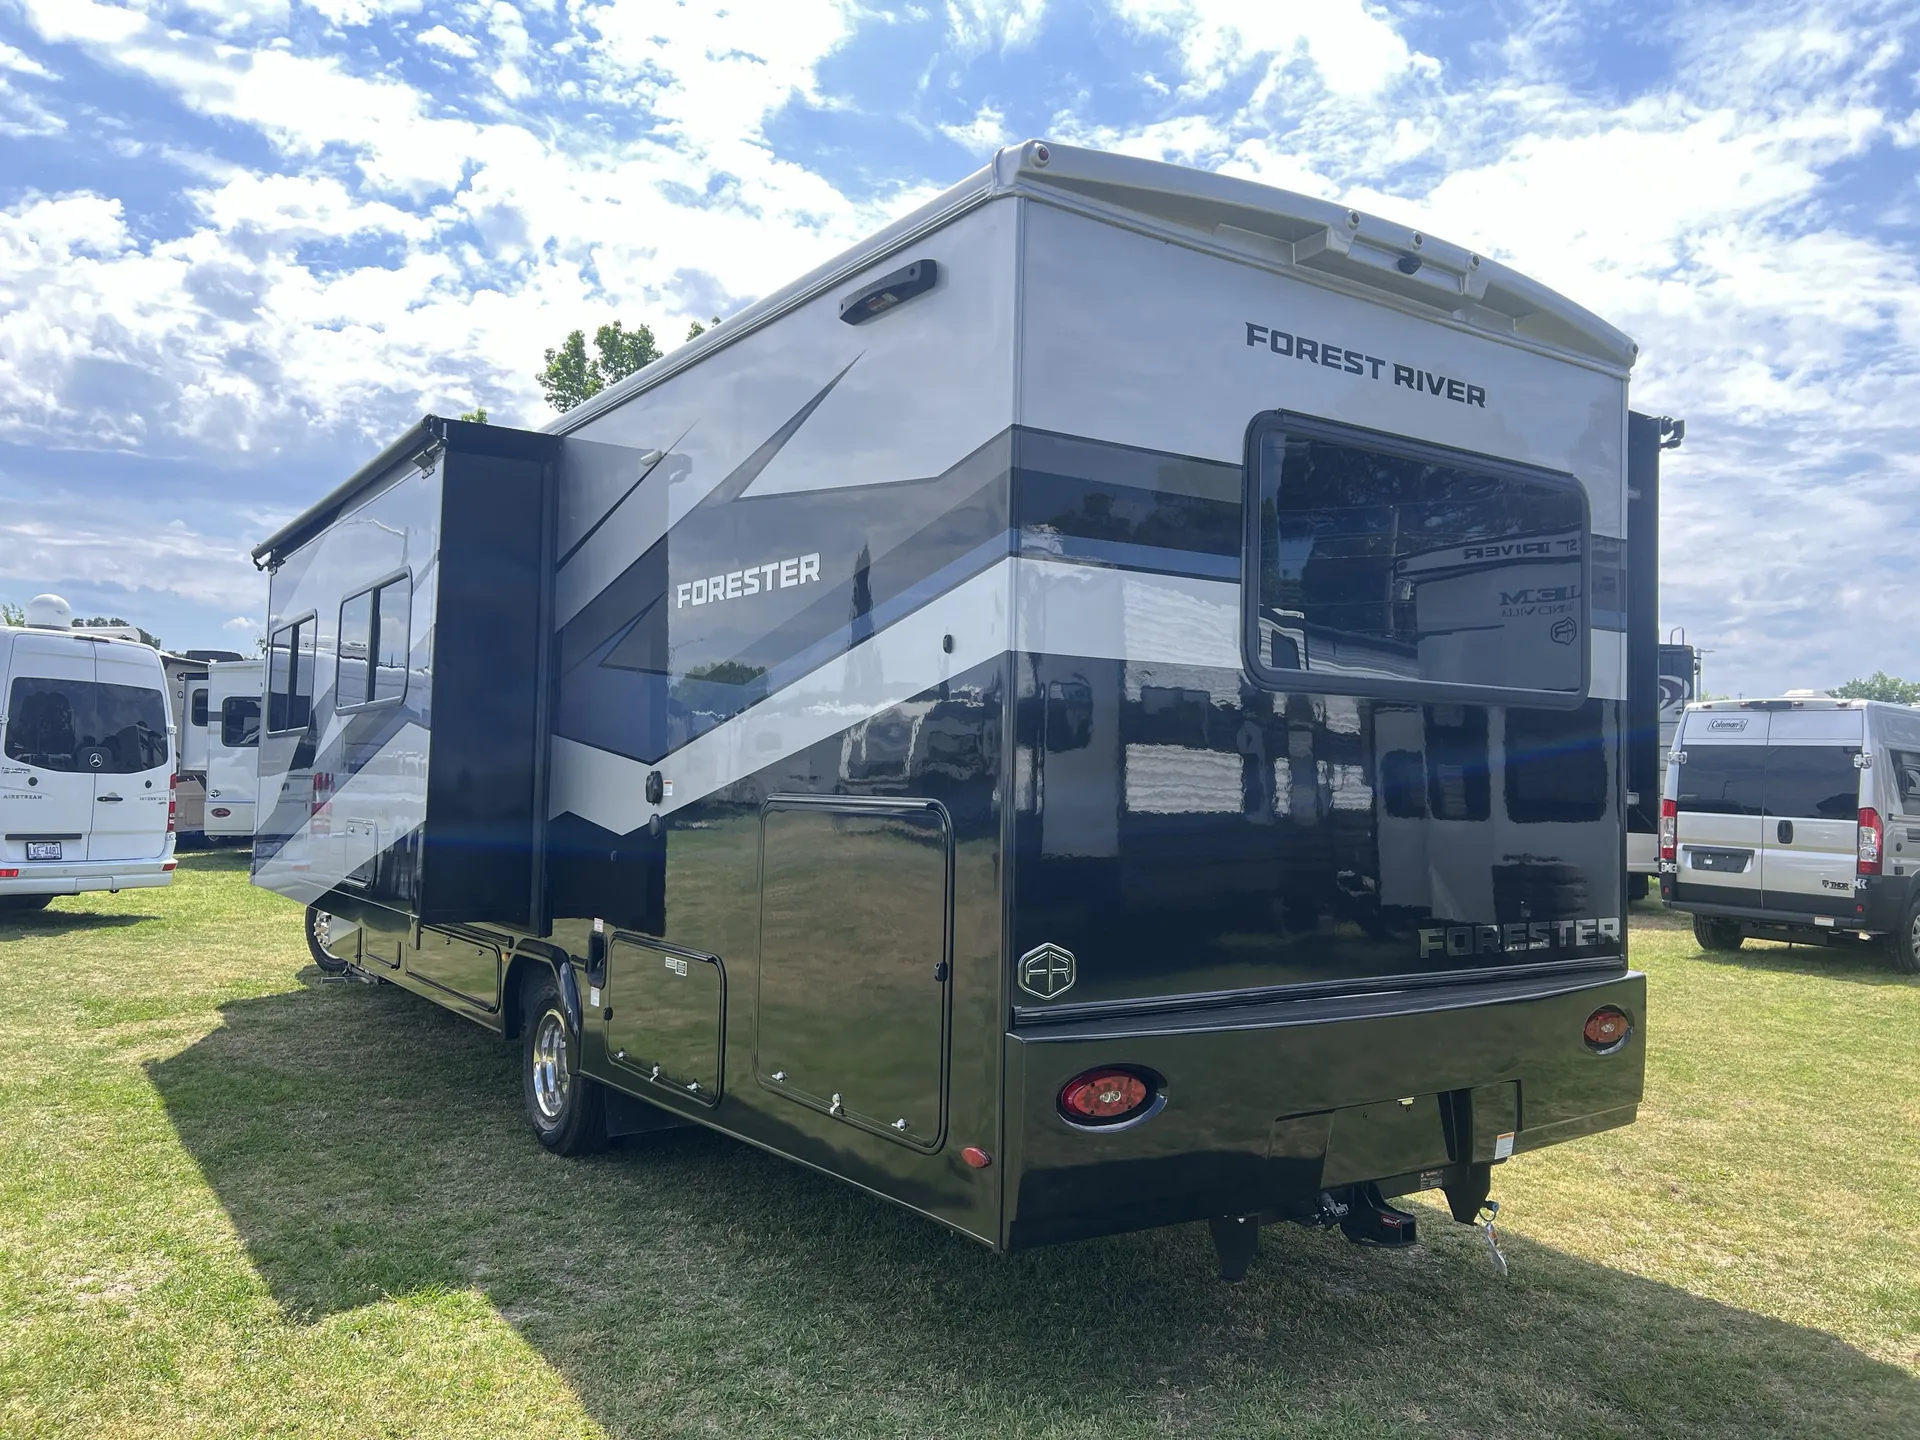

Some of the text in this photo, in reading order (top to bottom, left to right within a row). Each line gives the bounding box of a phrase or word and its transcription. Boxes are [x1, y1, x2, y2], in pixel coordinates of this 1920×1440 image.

[1245, 322, 1486, 409] FOREST RIVER
[676, 552, 822, 609] FORESTER
[1711, 720, 1739, 729] Coleman
[1829, 881, 1849, 890] THOR
[1417, 917, 1621, 959] FORESTER
